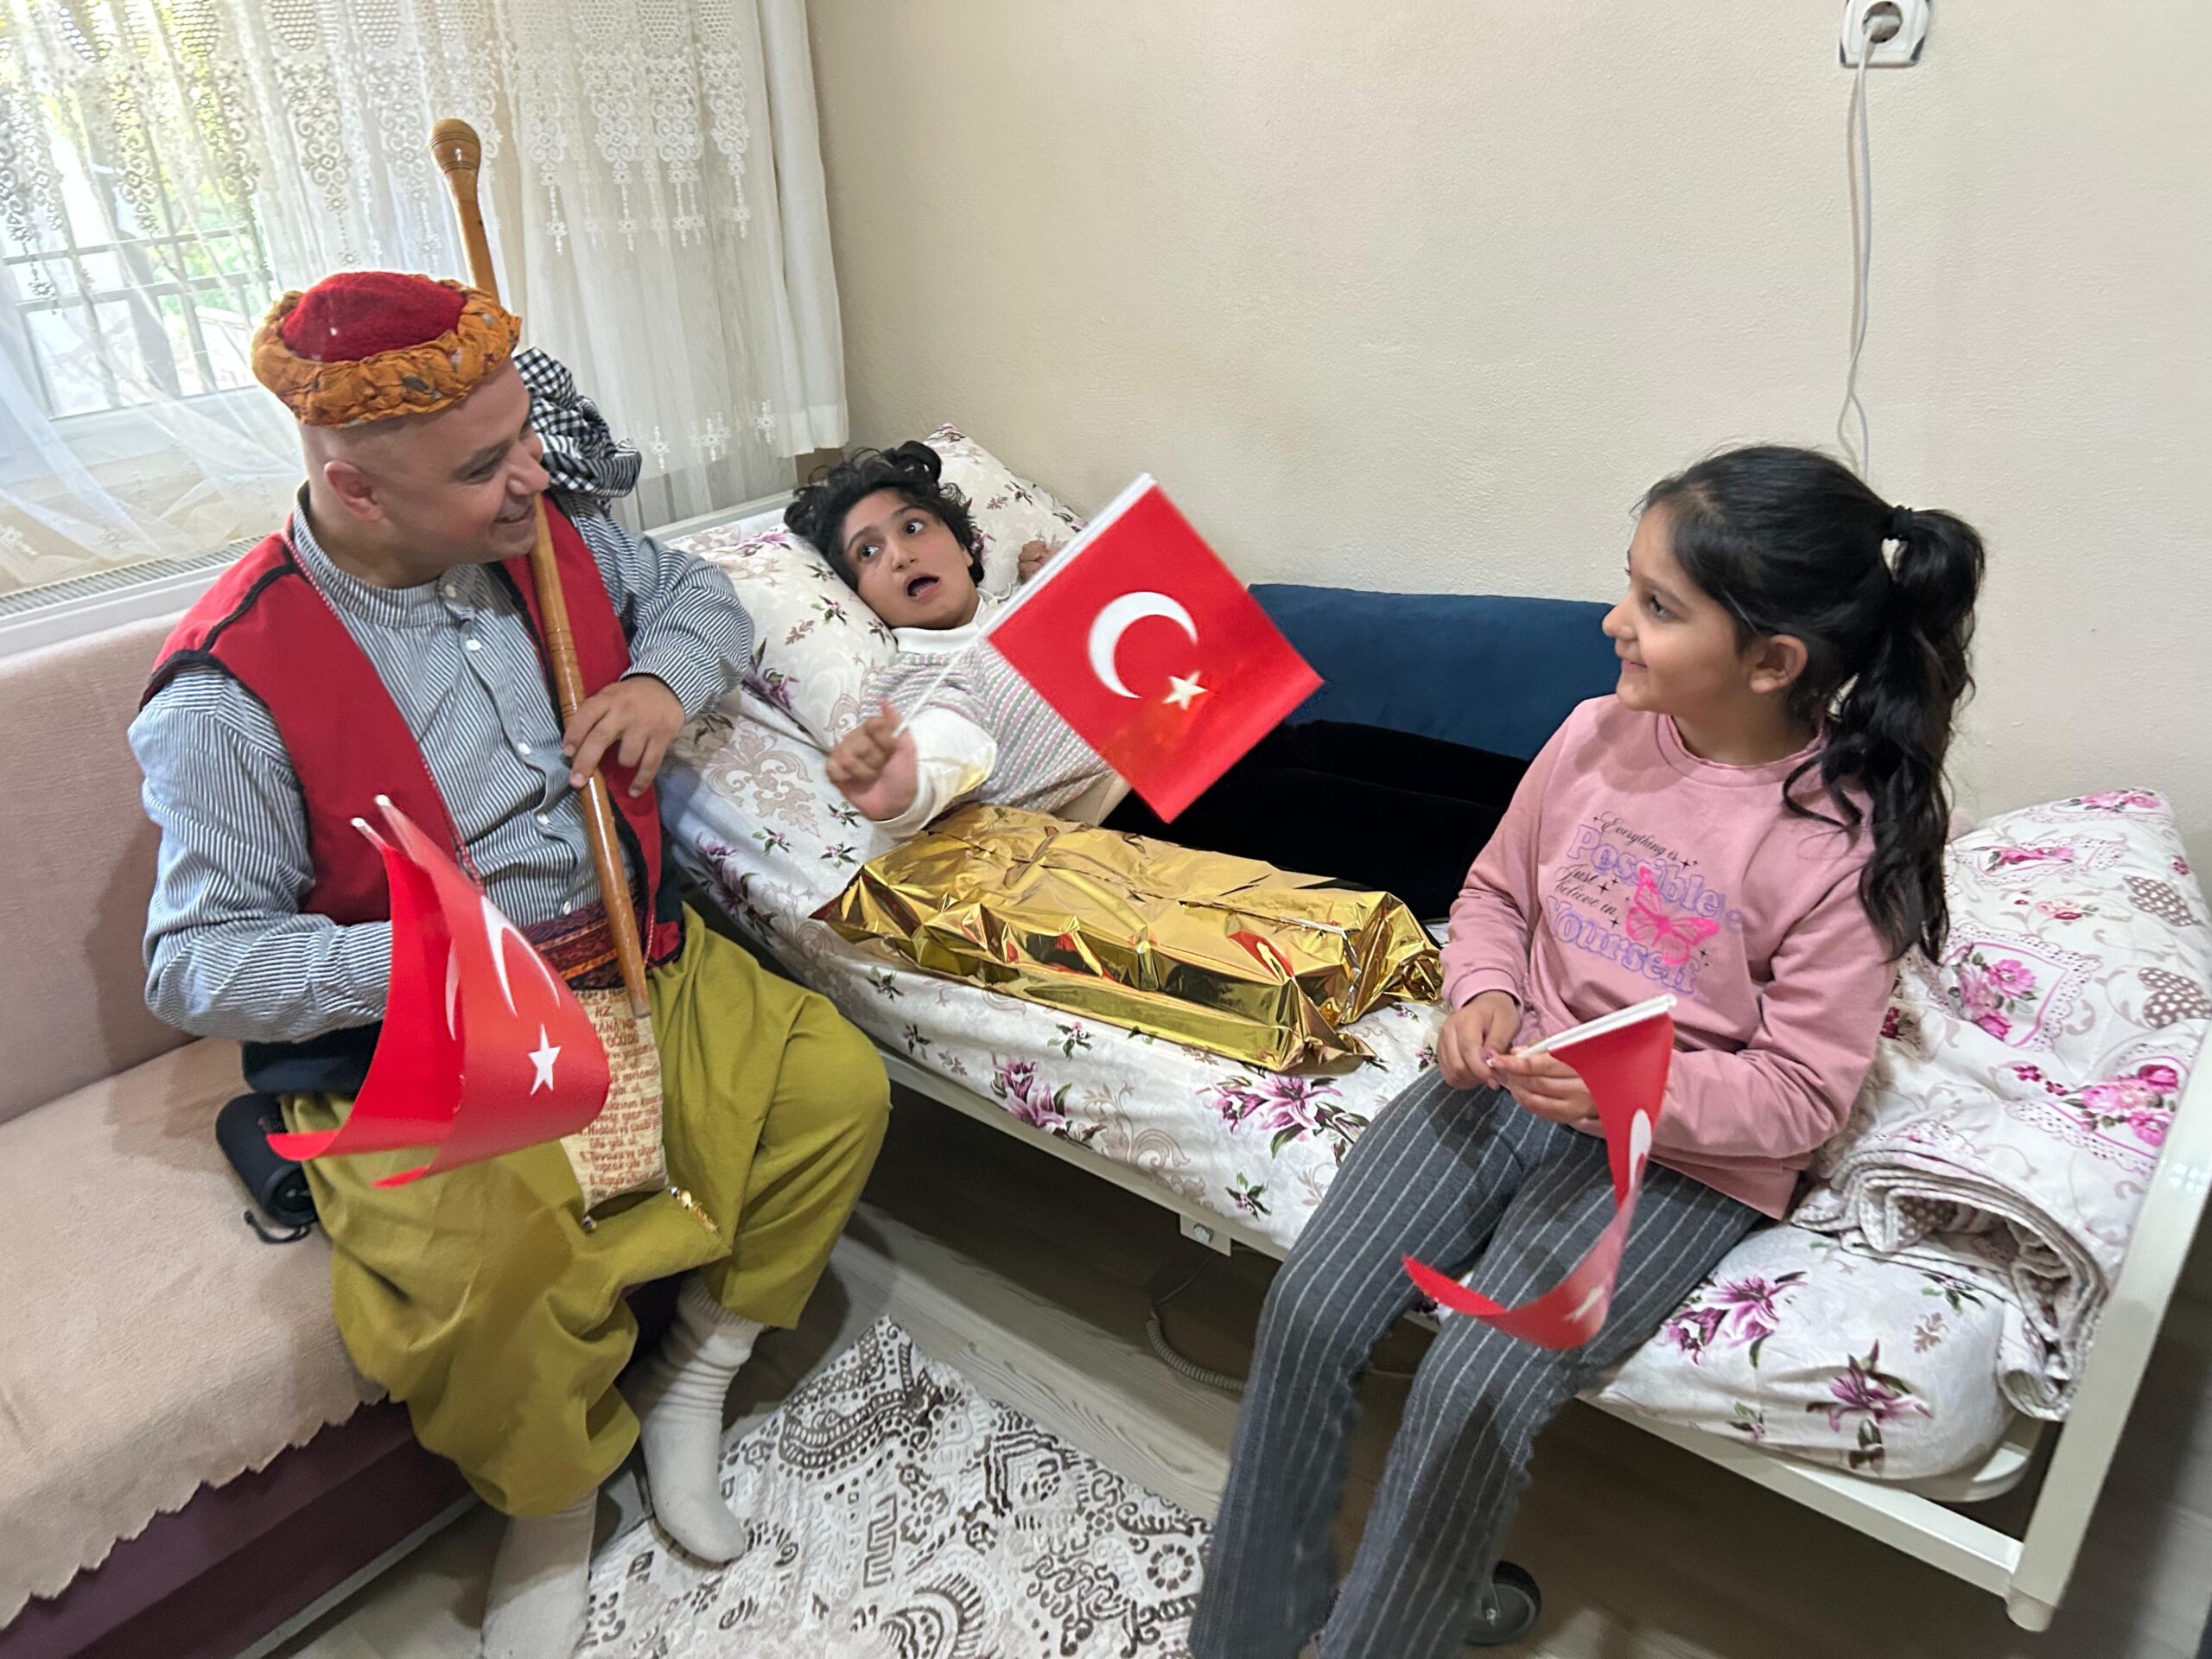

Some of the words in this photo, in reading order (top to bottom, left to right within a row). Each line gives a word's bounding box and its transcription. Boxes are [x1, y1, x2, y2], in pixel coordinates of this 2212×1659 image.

[1600, 811, 1666, 856] Everything
[1667, 849, 1679, 861] is
[1554, 863, 1599, 883] Just
[1554, 880, 1599, 906] believe
[1600, 903, 1617, 915] in
[1546, 895, 1700, 995] Yourself
